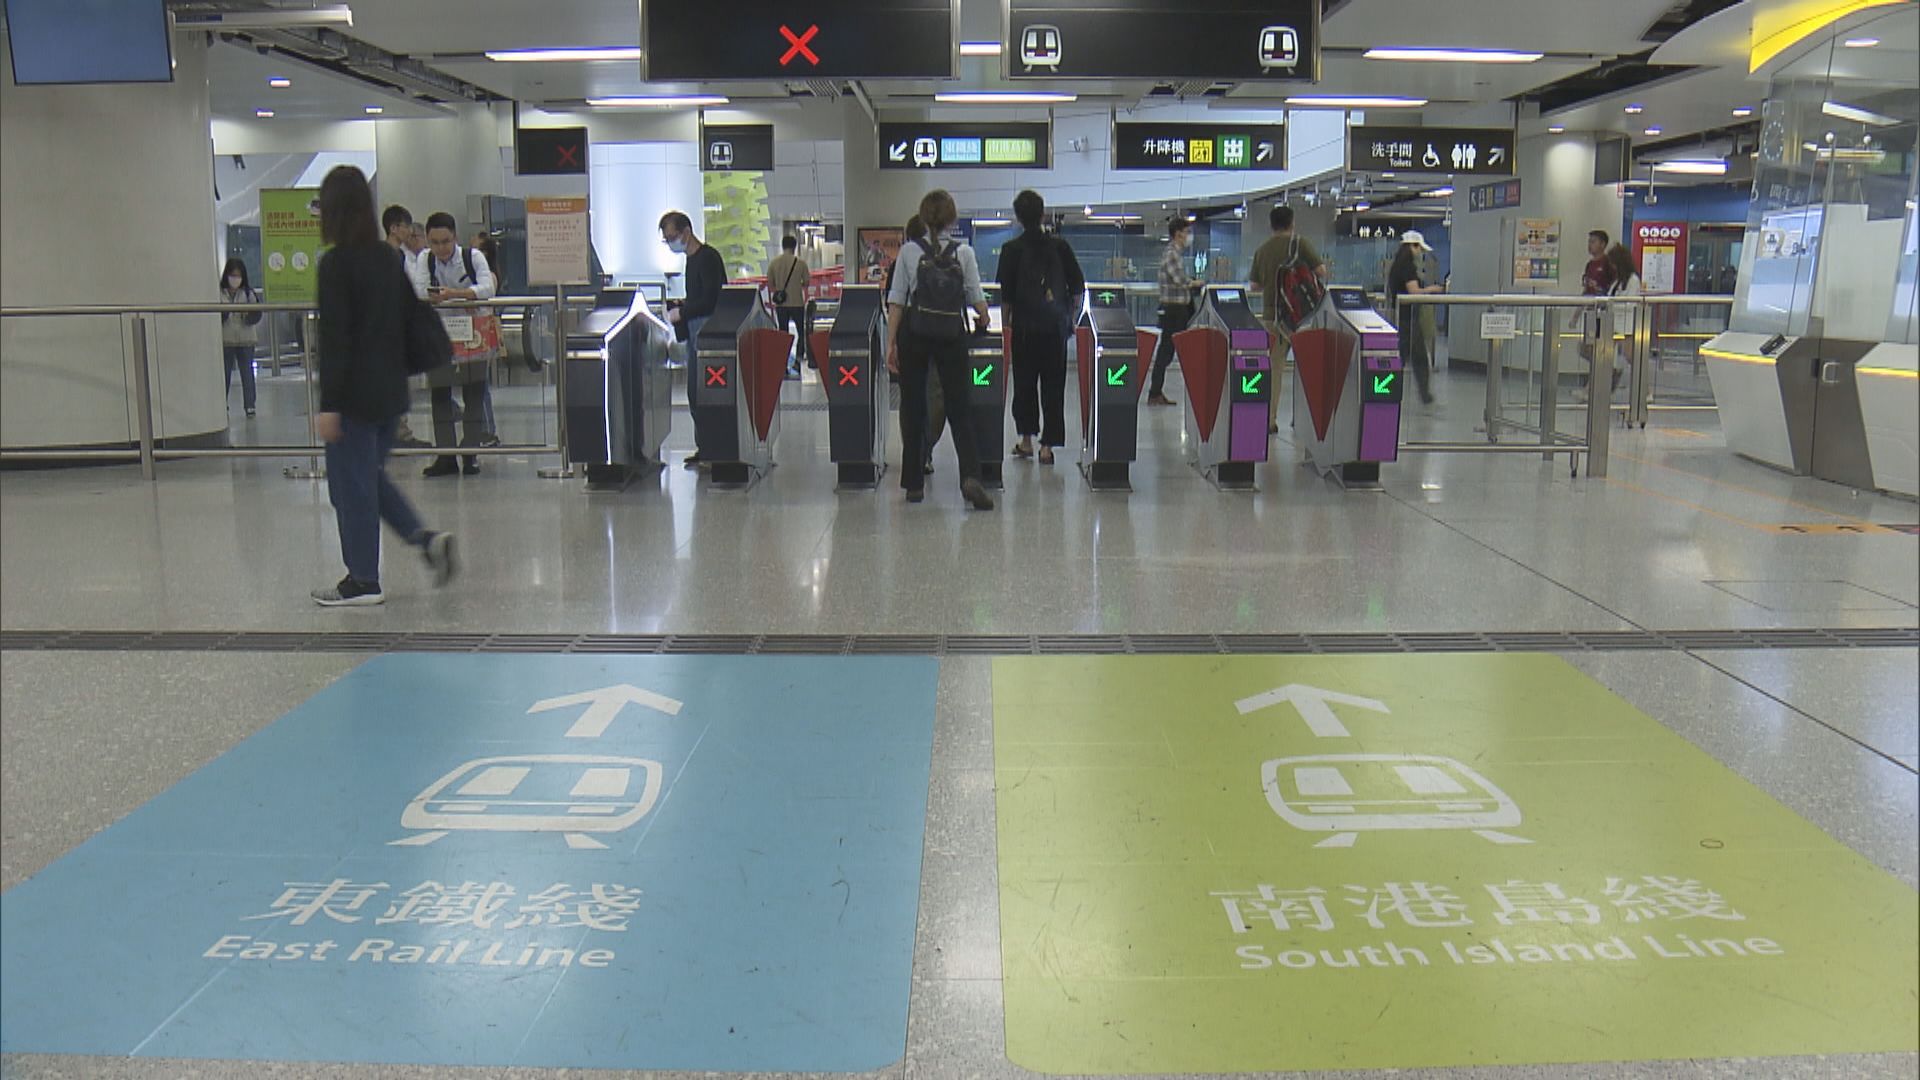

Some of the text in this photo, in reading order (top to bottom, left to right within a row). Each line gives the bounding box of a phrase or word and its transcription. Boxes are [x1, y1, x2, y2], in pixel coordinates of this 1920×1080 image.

[1143, 138, 1185, 155] 升降機
[1371, 142, 1413, 158] 洗手間
[1390, 158, 1413, 168] Toilets
[239, 878, 643, 931] 東鐵綫
[1209, 876, 1745, 933] 南港島綫
[203, 936, 615, 967] East Rail Line
[1234, 933, 1784, 969] South Island Line
